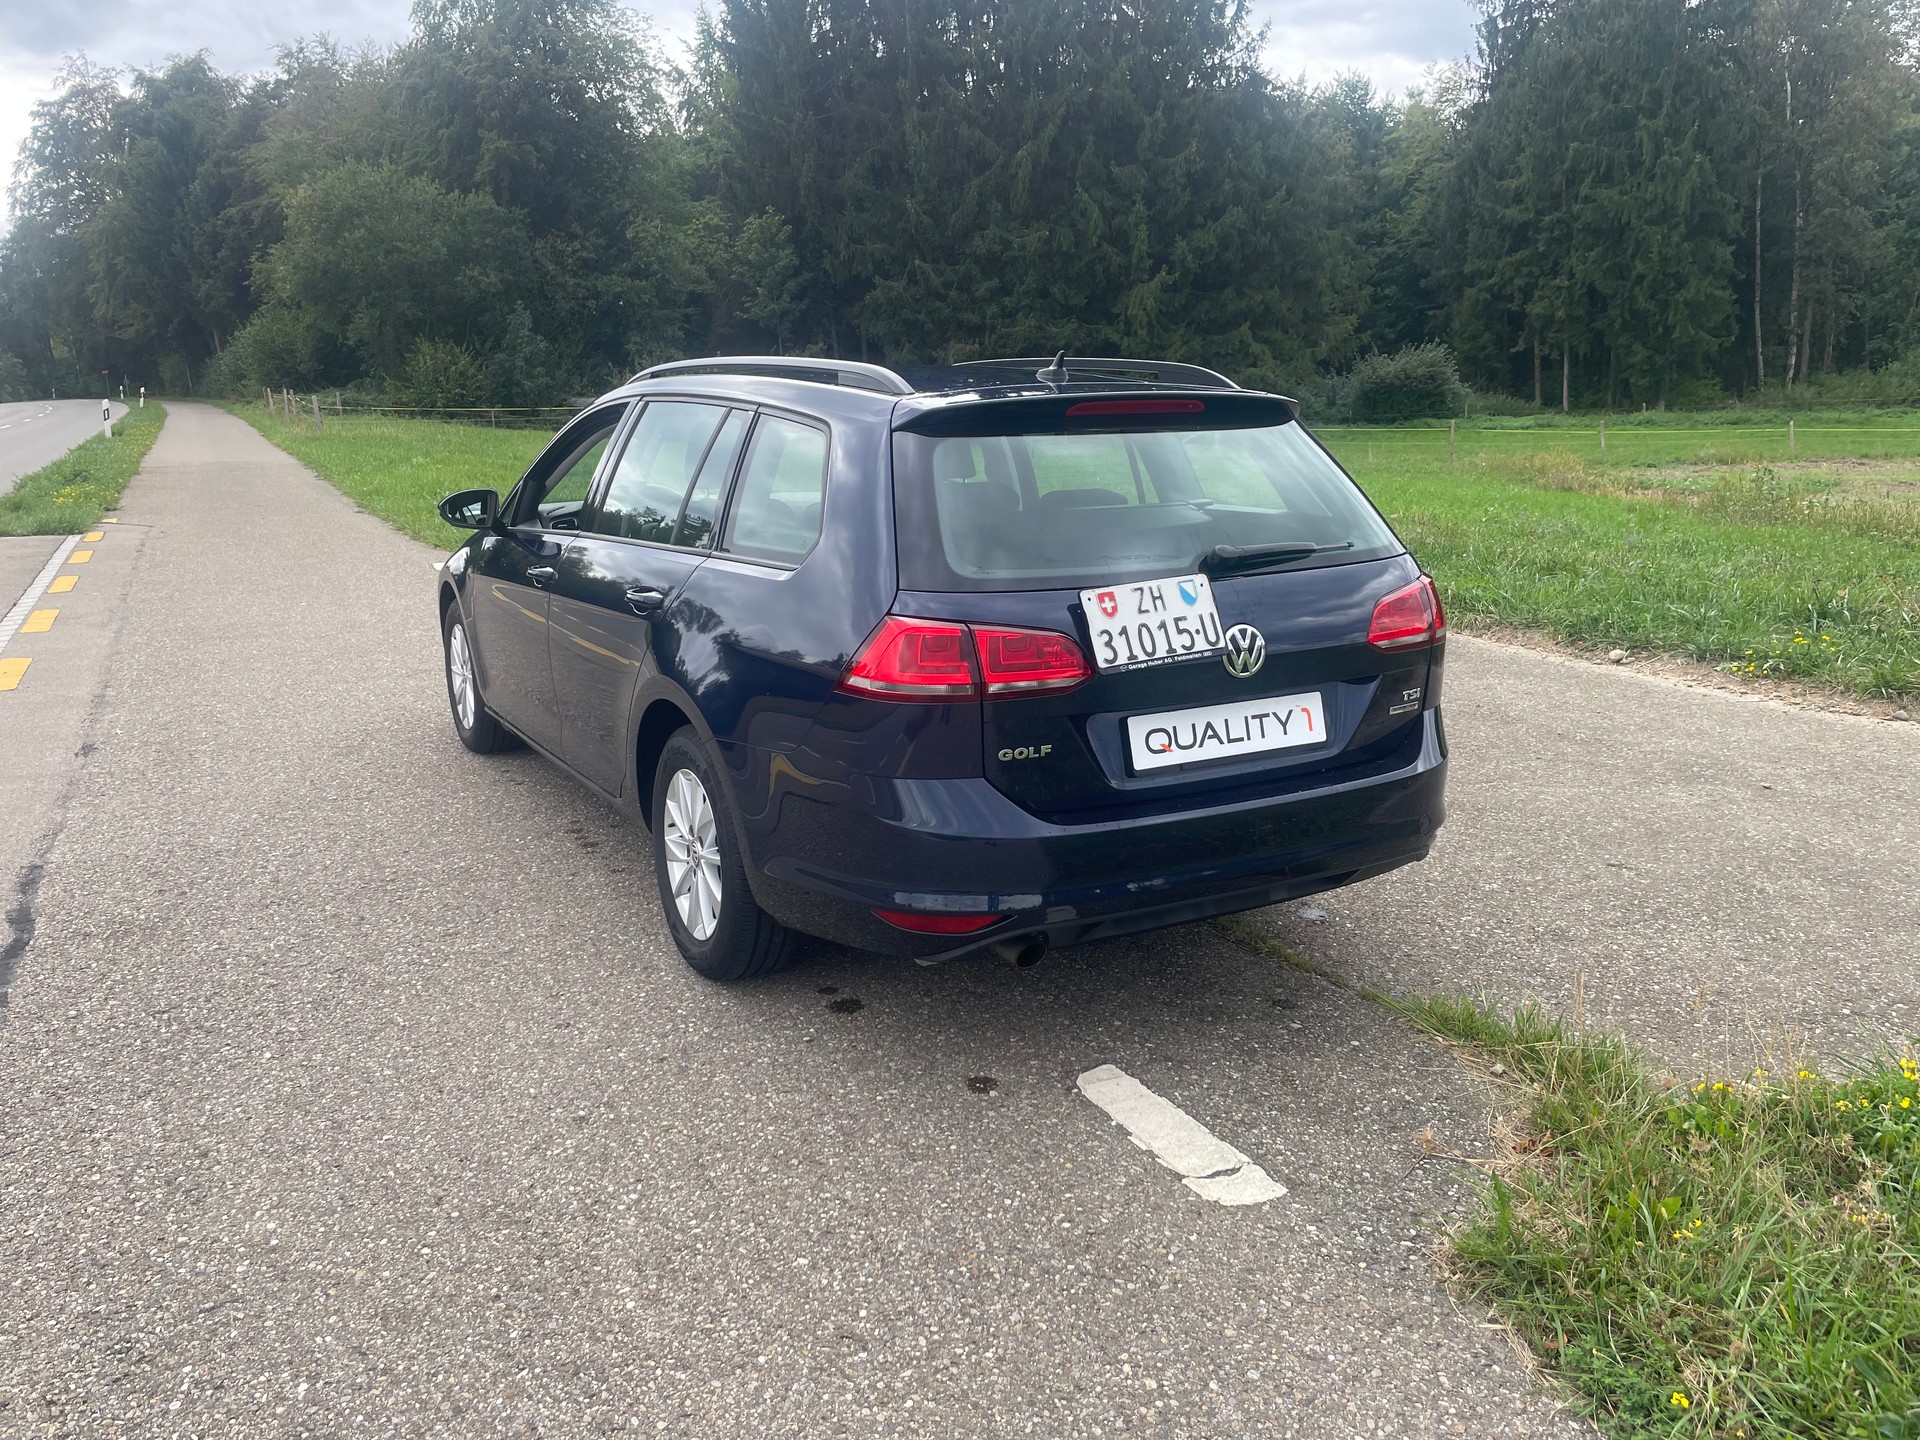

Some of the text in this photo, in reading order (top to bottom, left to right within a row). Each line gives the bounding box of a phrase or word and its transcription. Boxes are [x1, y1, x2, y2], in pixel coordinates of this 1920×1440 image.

[1131, 584, 1167, 614] ZH
[1128, 661, 1148, 670] Garage
[1148, 659, 1163, 667] Huber
[1402, 687, 1421, 701] TSI
[1144, 709, 1294, 755] QUALITY
[998, 744, 1053, 761] GOLF
